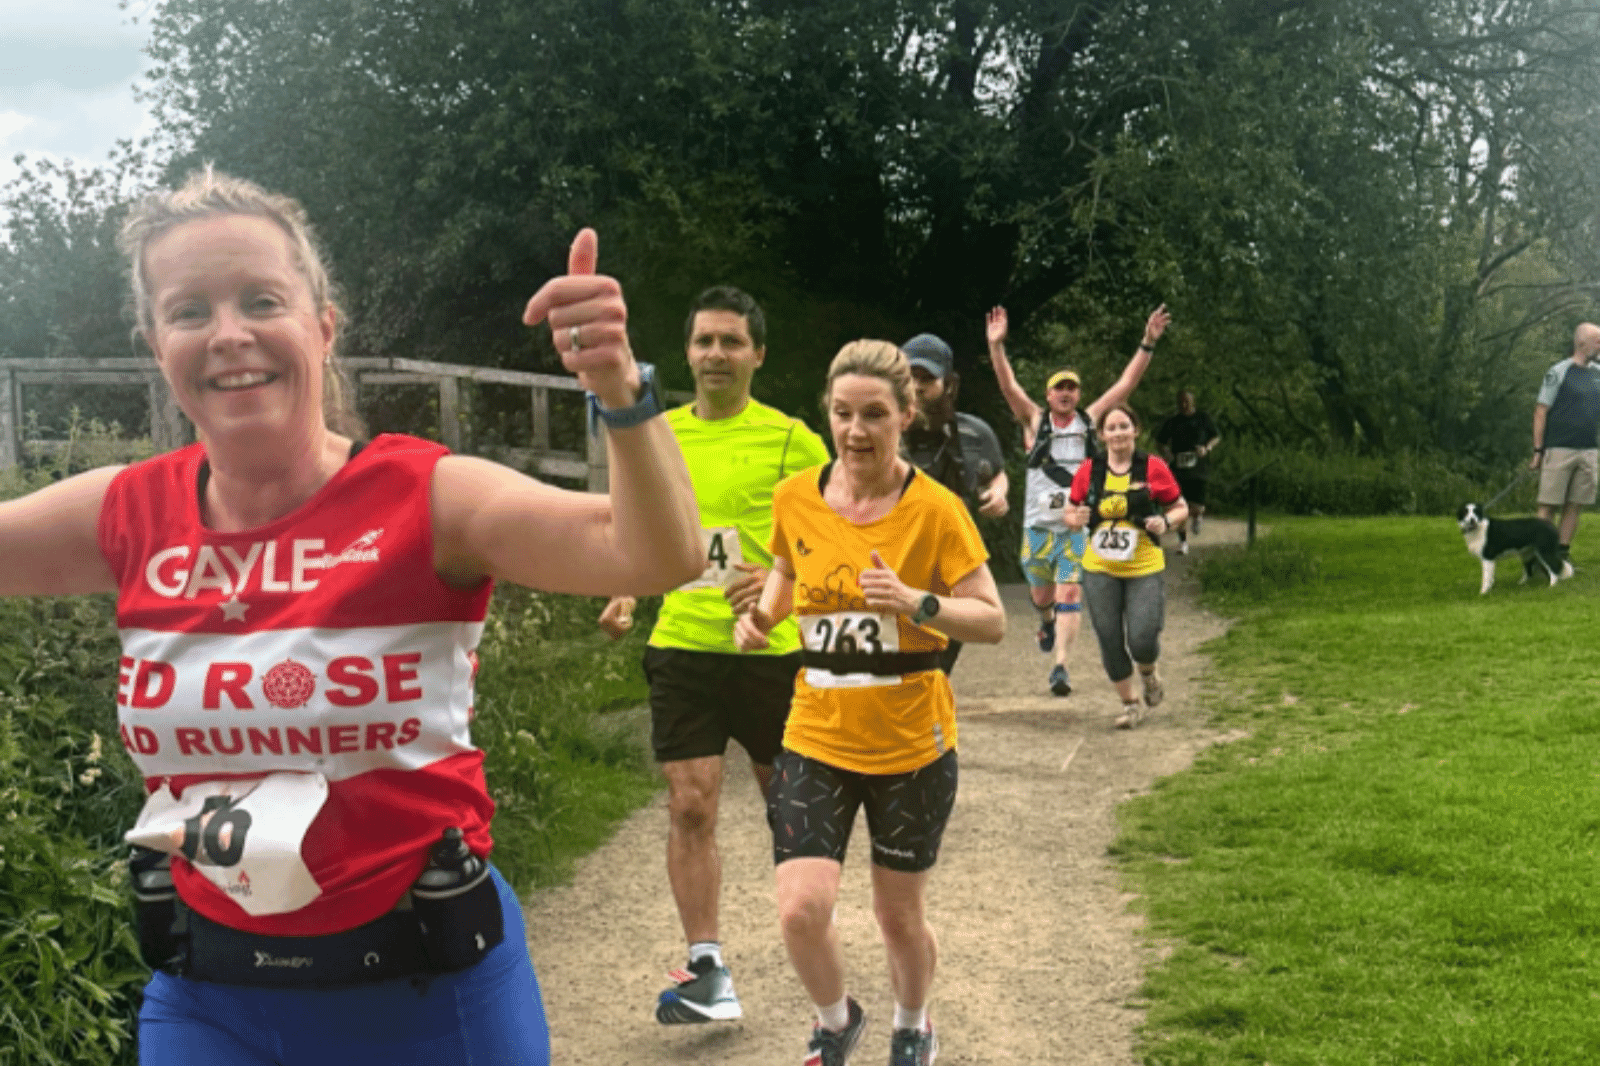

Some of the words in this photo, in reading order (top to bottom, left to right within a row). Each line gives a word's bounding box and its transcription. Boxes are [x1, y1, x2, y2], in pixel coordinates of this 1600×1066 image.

[708, 531, 729, 570] 4
[1098, 531, 1131, 551] 235
[144, 538, 327, 600] GAYLE
[815, 617, 883, 655] 263
[174, 716, 422, 757] RUNNERS
